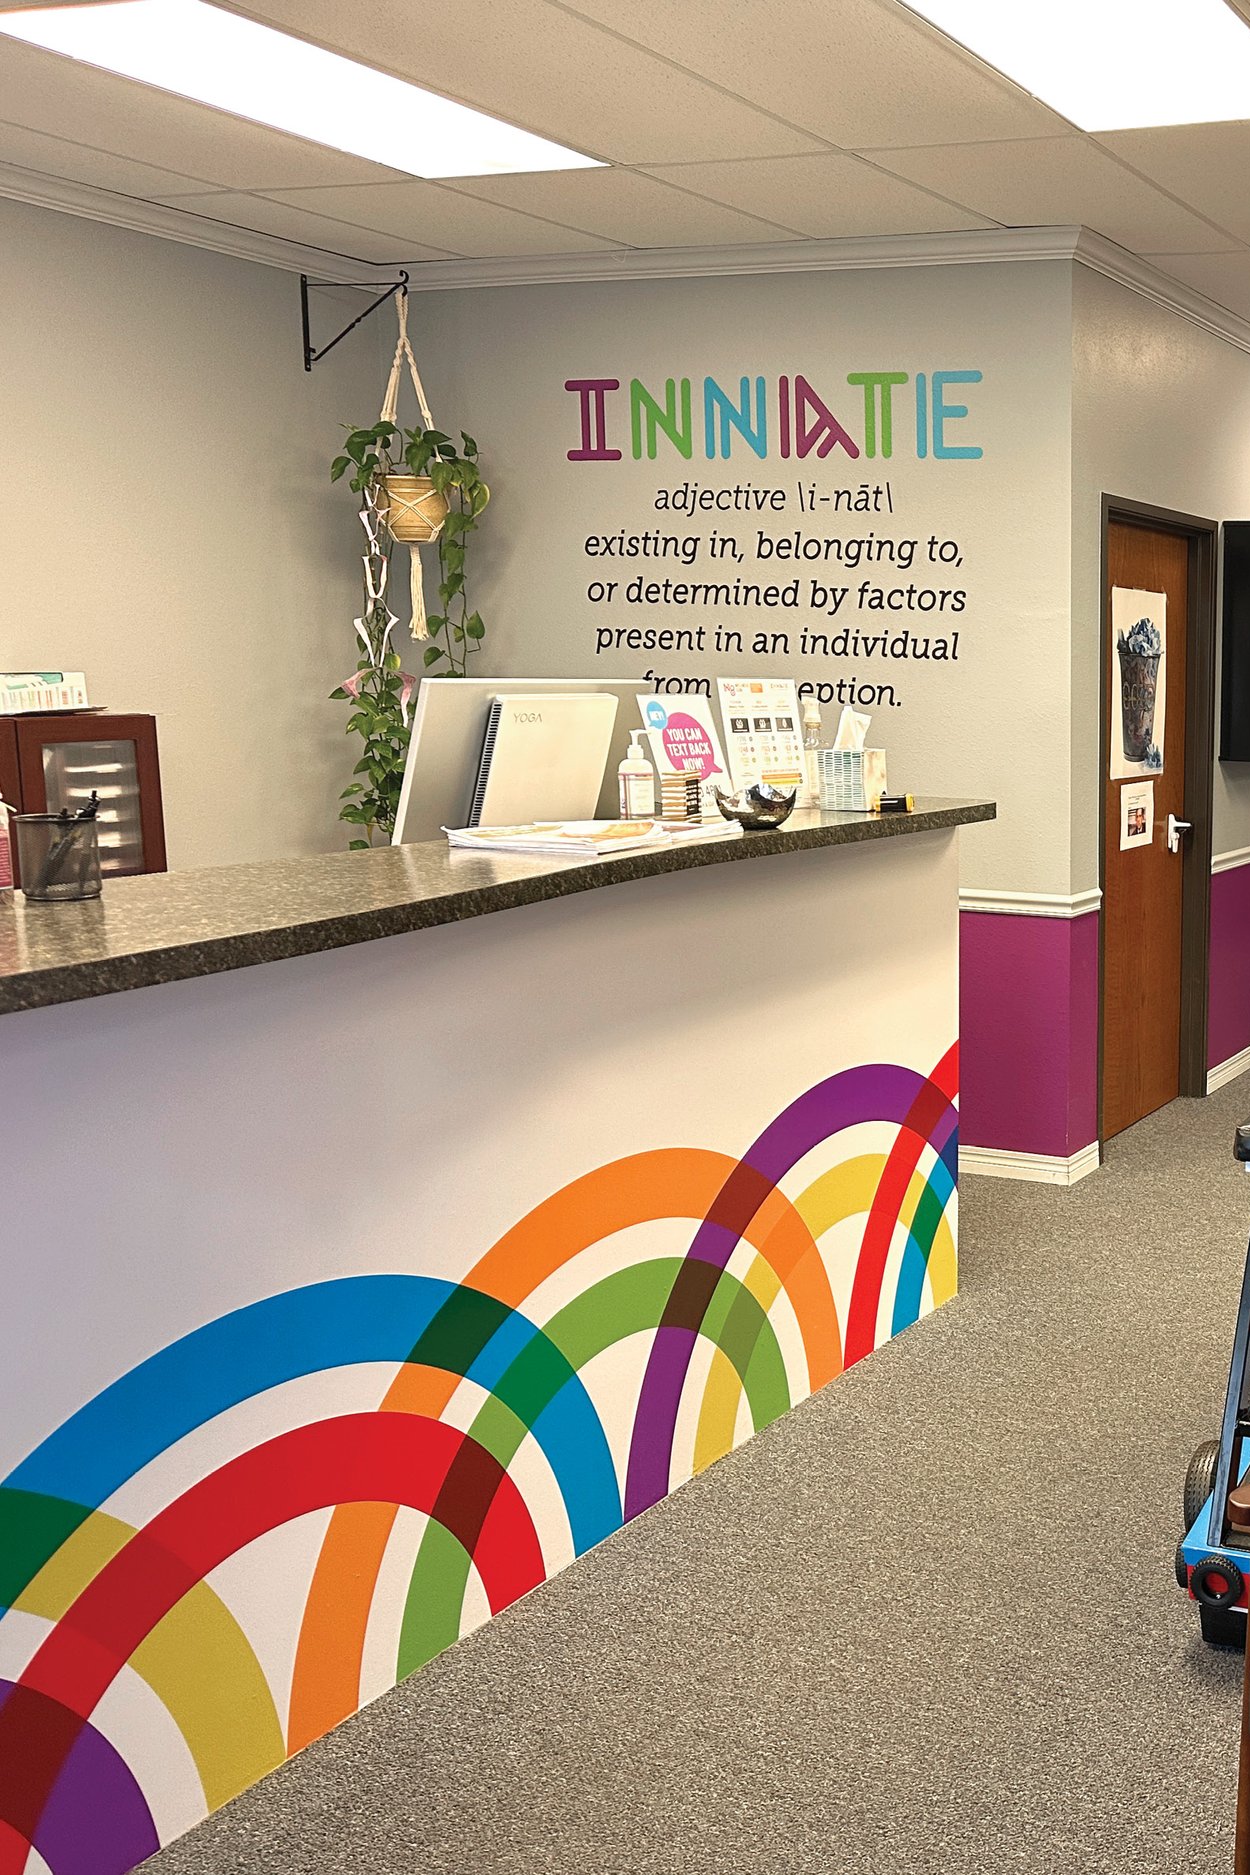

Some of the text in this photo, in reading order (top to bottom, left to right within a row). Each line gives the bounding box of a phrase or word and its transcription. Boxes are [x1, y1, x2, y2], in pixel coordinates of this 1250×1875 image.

[564, 370, 984, 462] INNATE
[654, 482, 786, 517] adjective
[584, 529, 963, 570] existing in, belonging to,
[587, 576, 967, 616] or determined by factors
[596, 624, 960, 661] present in an individual
[797, 677, 902, 707] eption.
[513, 712, 543, 723] YOGA
[667, 727, 702, 741] YOU CAN
[667, 742, 711, 756] TEXT BACK
[682, 757, 705, 770] NOW!
